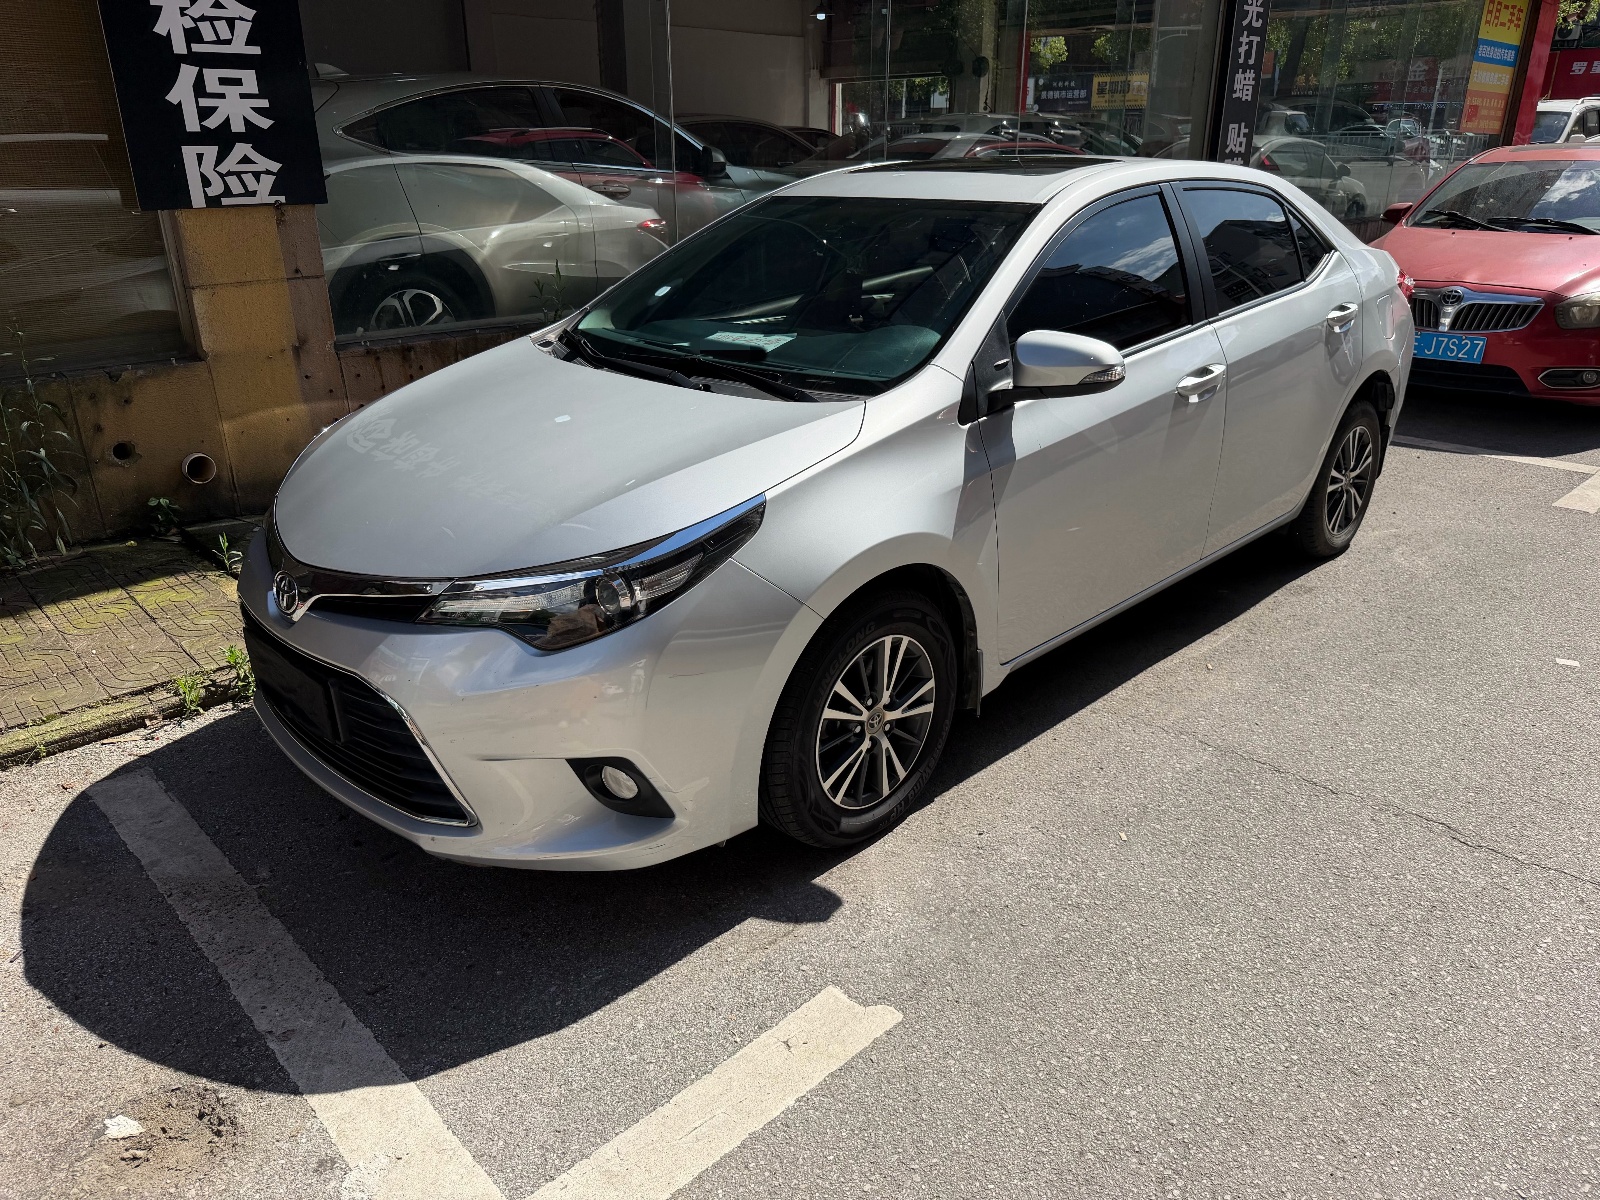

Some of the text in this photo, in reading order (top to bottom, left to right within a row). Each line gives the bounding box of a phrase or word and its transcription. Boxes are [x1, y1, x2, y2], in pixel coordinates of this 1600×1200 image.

[150, 0, 286, 208] 检保险
[1224, 122, 1249, 165] 贴
